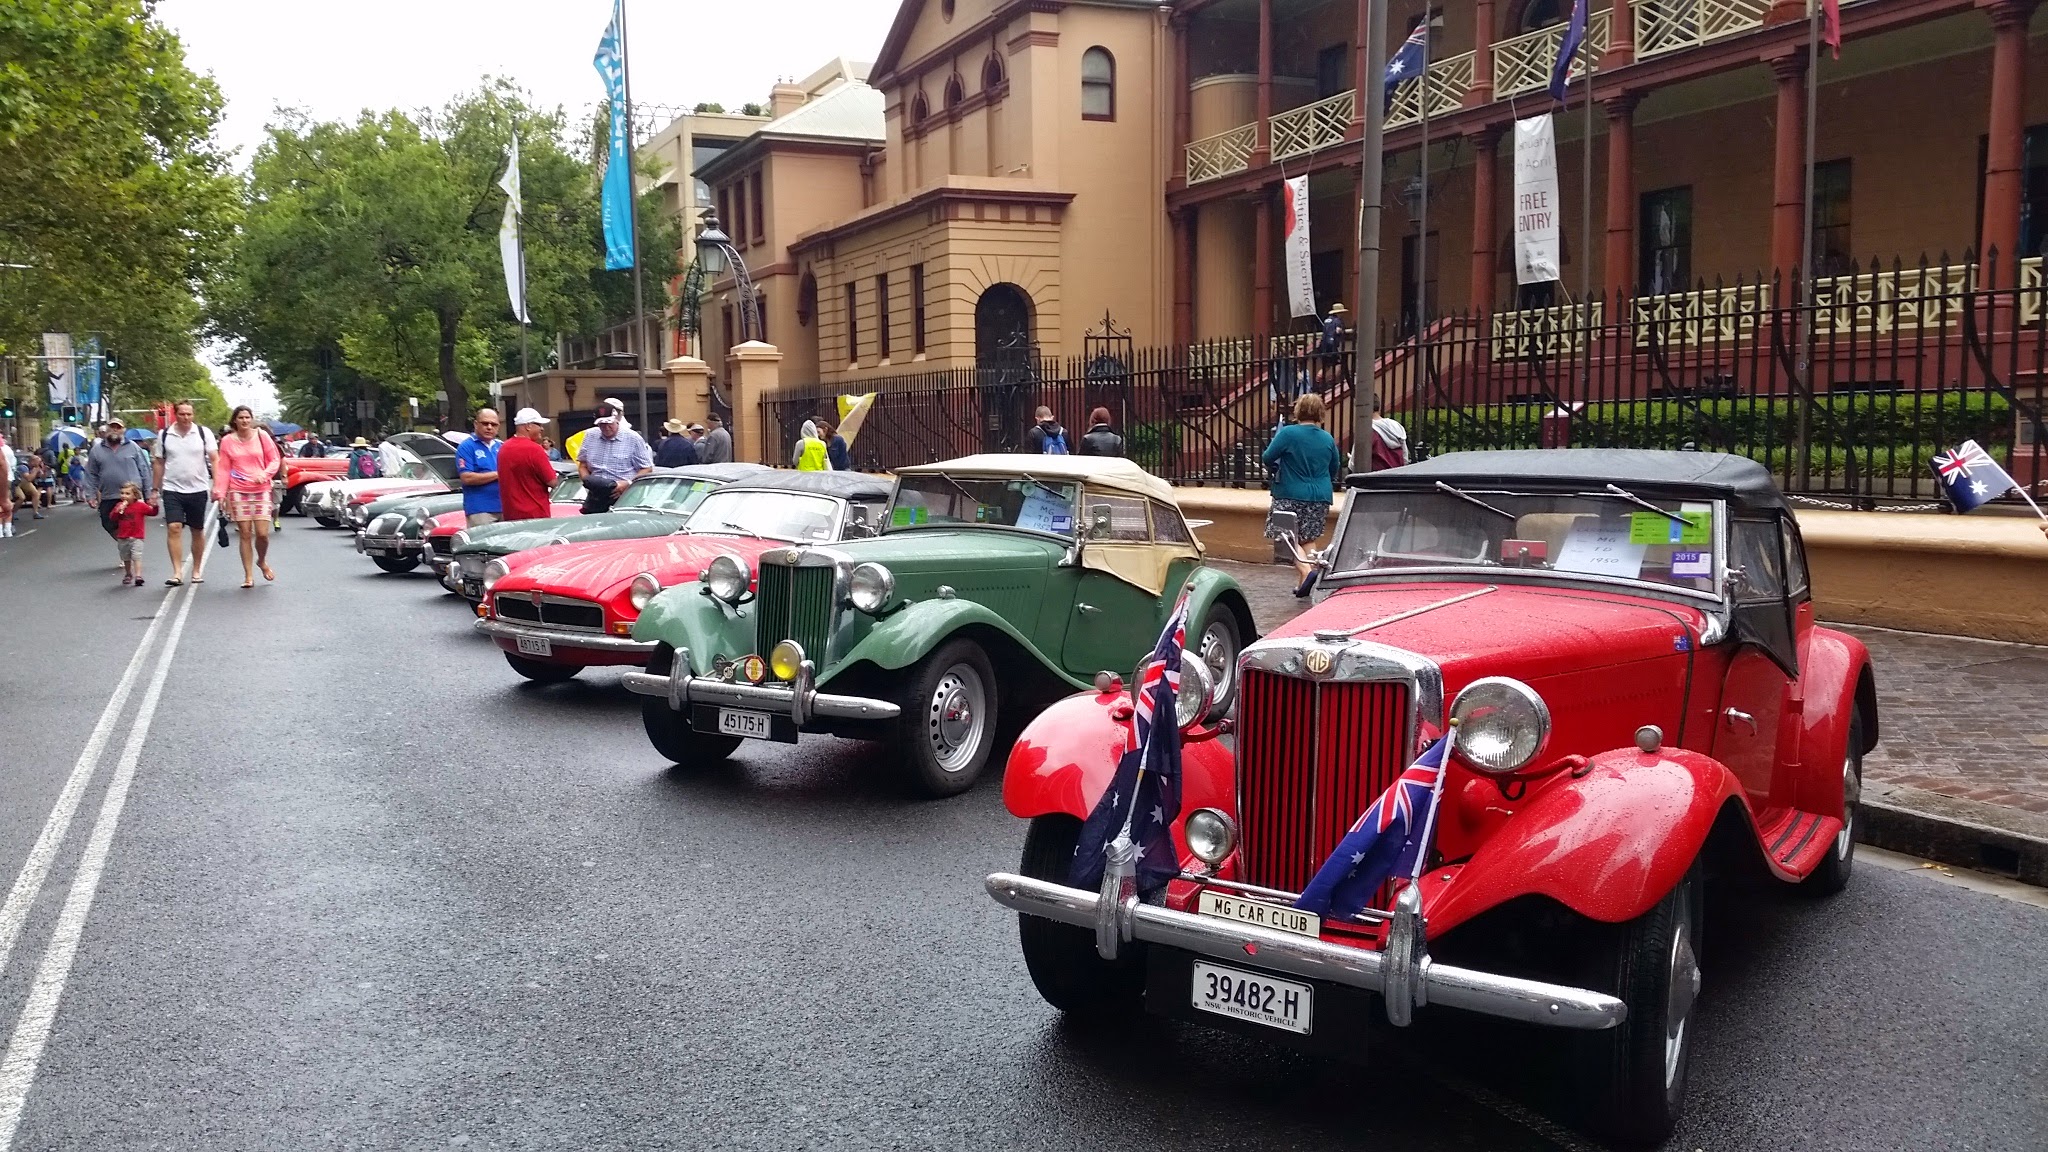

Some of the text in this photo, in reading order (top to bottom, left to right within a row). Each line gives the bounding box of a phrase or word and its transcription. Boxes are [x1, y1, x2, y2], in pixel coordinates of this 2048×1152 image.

[1520, 191, 1548, 211] FREE
[1518, 212, 1552, 232] ENTRY
[1675, 553, 1697, 561] 2015
[1309, 652, 1328, 670] MG
[1214, 899, 1308, 931] MG CAR CLUB
[1204, 1000, 1221, 1010] NSW
[1227, 1005, 1262, 1020] HISTORIC
[1264, 1014, 1297, 1028] VEHICLE
